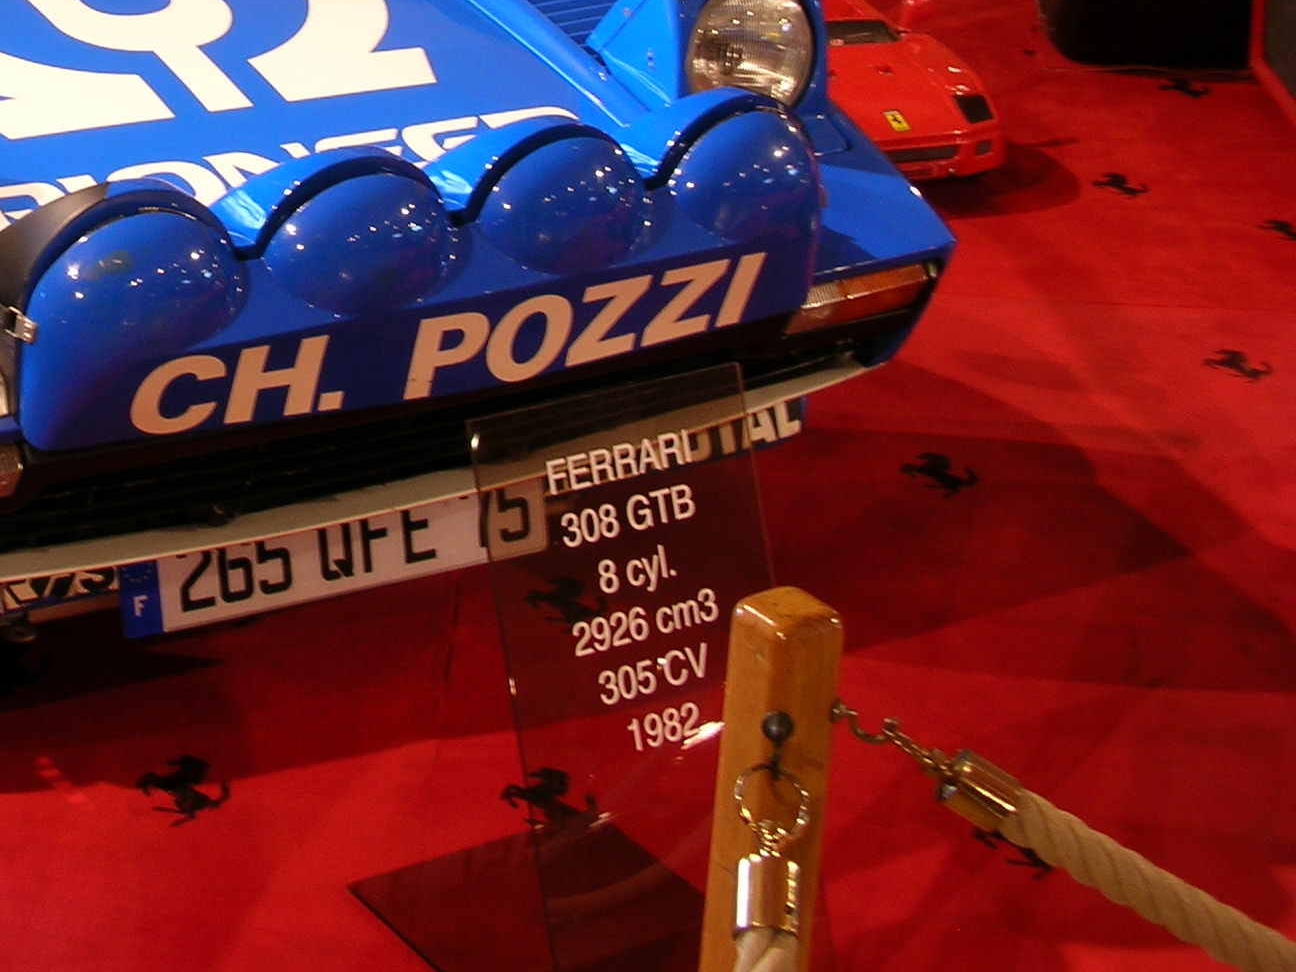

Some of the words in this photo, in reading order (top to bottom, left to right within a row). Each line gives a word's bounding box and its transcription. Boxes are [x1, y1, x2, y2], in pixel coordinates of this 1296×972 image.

[130, 335, 344, 435] CH.
[404, 252, 767, 400] POZZI
[545, 429, 693, 495] FERRARI
[560, 504, 620, 547] 308
[626, 484, 696, 532] GTB
[133, 595, 146, 617] F
[180, 540, 292, 612] 265
[317, 509, 437, 582] QFE
[598, 559, 619, 594] 8
[626, 544, 677, 591] cyl.
[572, 607, 650, 657] 2926
[655, 588, 719, 634] cm3
[598, 659, 657, 705] 305
[661, 642, 708, 686] CV
[627, 702, 701, 751] 1982
